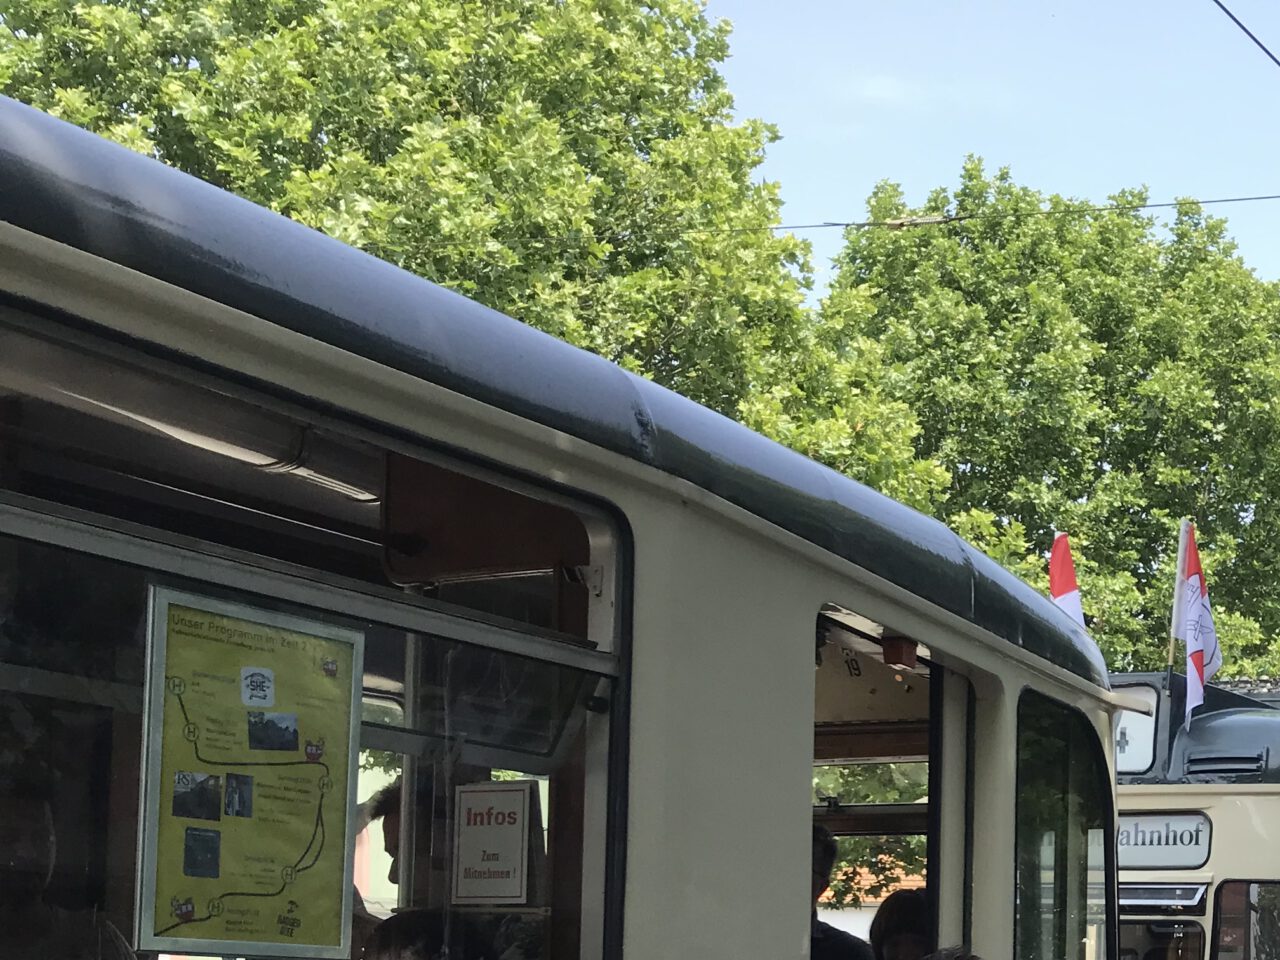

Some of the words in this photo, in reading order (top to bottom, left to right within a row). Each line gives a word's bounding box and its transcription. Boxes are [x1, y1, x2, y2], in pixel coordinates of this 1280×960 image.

[171, 613, 204, 631] Unser
[208, 621, 264, 642] Programm
[249, 680, 267, 693] SHE
[466, 806, 518, 827] Infos
[1118, 821, 1205, 847] ahnhof
[481, 850, 500, 862] Zum
[463, 867, 511, 880] Mitnehmen
